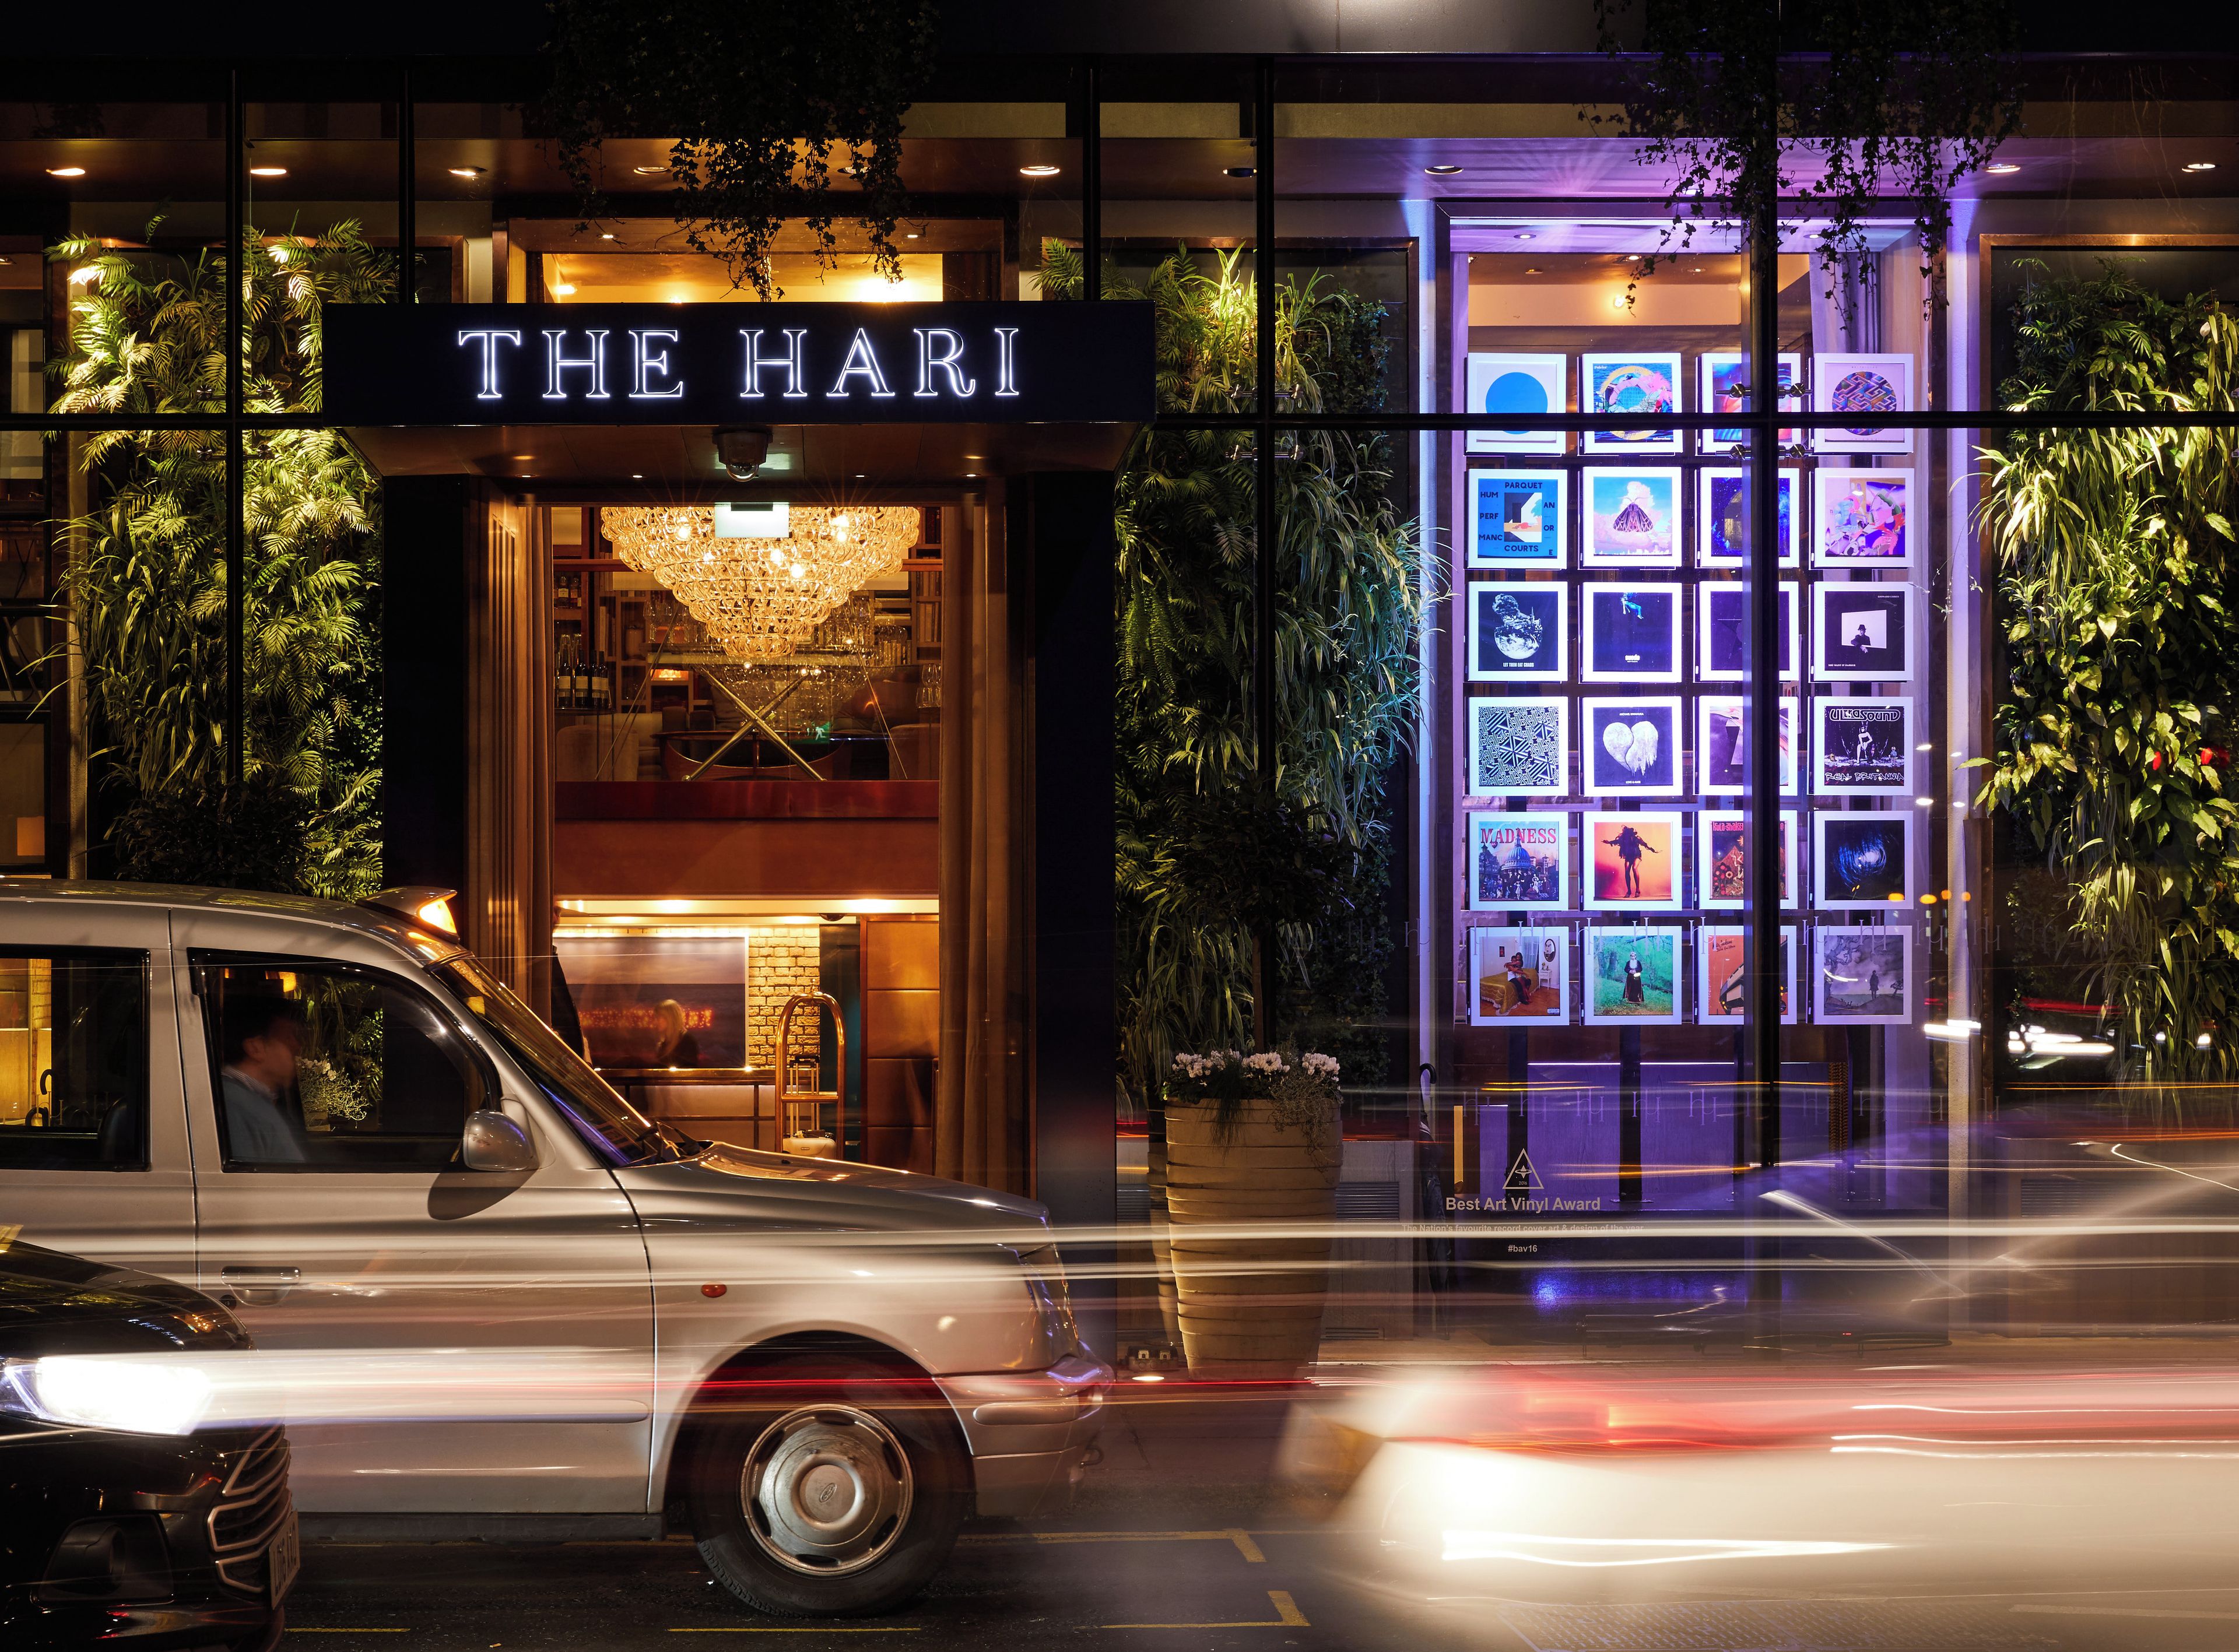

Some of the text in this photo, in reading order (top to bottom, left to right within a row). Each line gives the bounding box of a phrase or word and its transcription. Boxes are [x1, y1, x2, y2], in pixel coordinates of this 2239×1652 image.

[458, 327, 1020, 398] THE HARI
[1825, 772, 1904, 782] REAL BRITANNIA
[1480, 828, 1557, 844] MADNESS
[1445, 1197, 1601, 1214] Best Art Vinyl Award
[1570, 1225, 1598, 1233] design
[1507, 1245, 1538, 1253] #bav16
